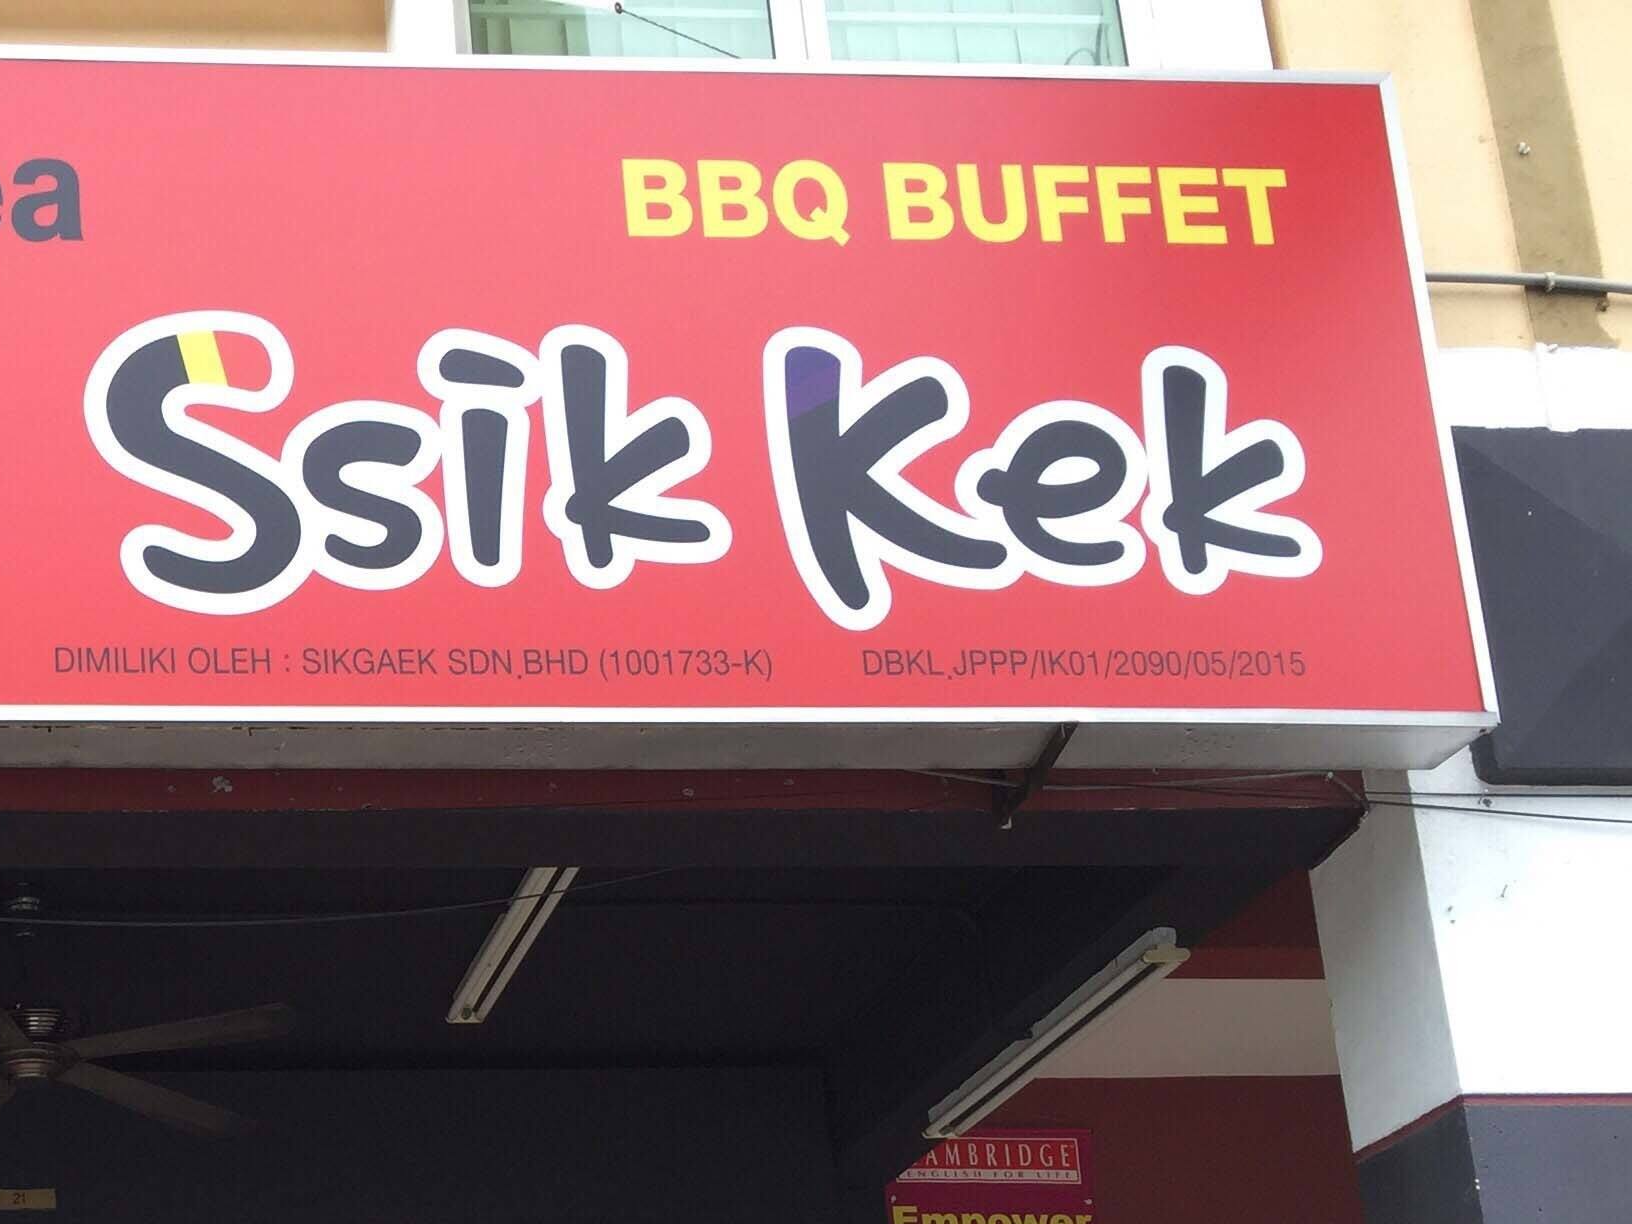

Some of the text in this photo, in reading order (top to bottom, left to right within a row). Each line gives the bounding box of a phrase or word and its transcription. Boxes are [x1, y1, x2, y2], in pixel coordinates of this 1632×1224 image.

[621, 158, 1287, 246] BBQ BUFFET
[84, 312, 1321, 630] Ssik Kek
[53, 647, 176, 674] DIMILIKI
[188, 648, 271, 675] OLEH
[302, 648, 438, 676] SIKGAEK
[599, 649, 774, 681] (1001733-K)
[914, 1142, 1071, 1168] AMBRIDGE
